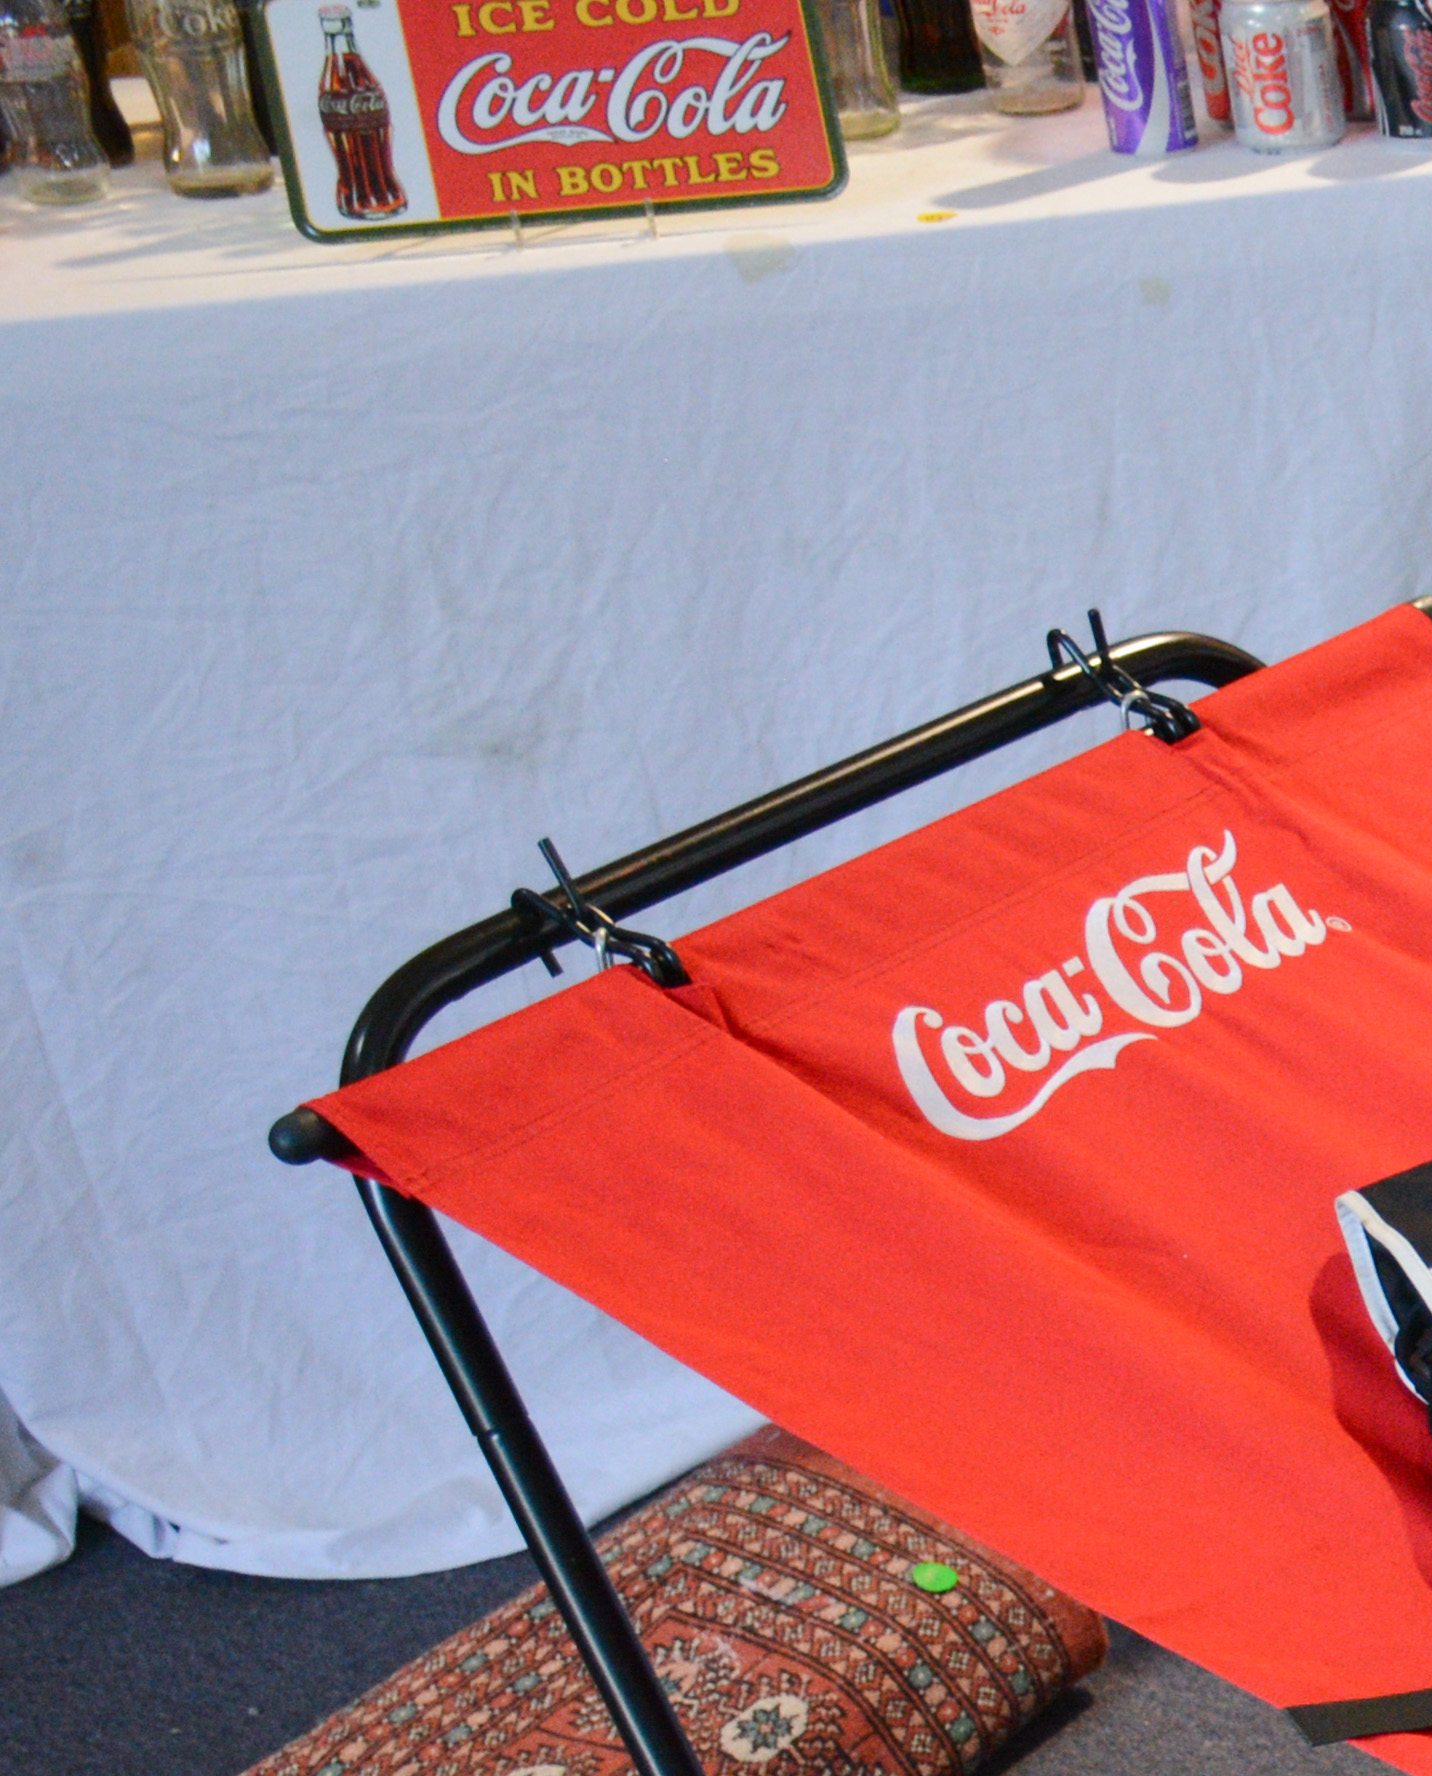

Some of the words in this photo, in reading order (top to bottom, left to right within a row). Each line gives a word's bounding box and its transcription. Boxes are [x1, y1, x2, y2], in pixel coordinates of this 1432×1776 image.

[453, 0, 556, 37] ICE
[437, 32, 792, 155] Coca-Cola
[1251, 31, 1295, 135] Coke
[488, 169, 540, 202] IN
[557, 149, 780, 197] BOTTLES
[892, 829, 1327, 1141] Coca-Cola
